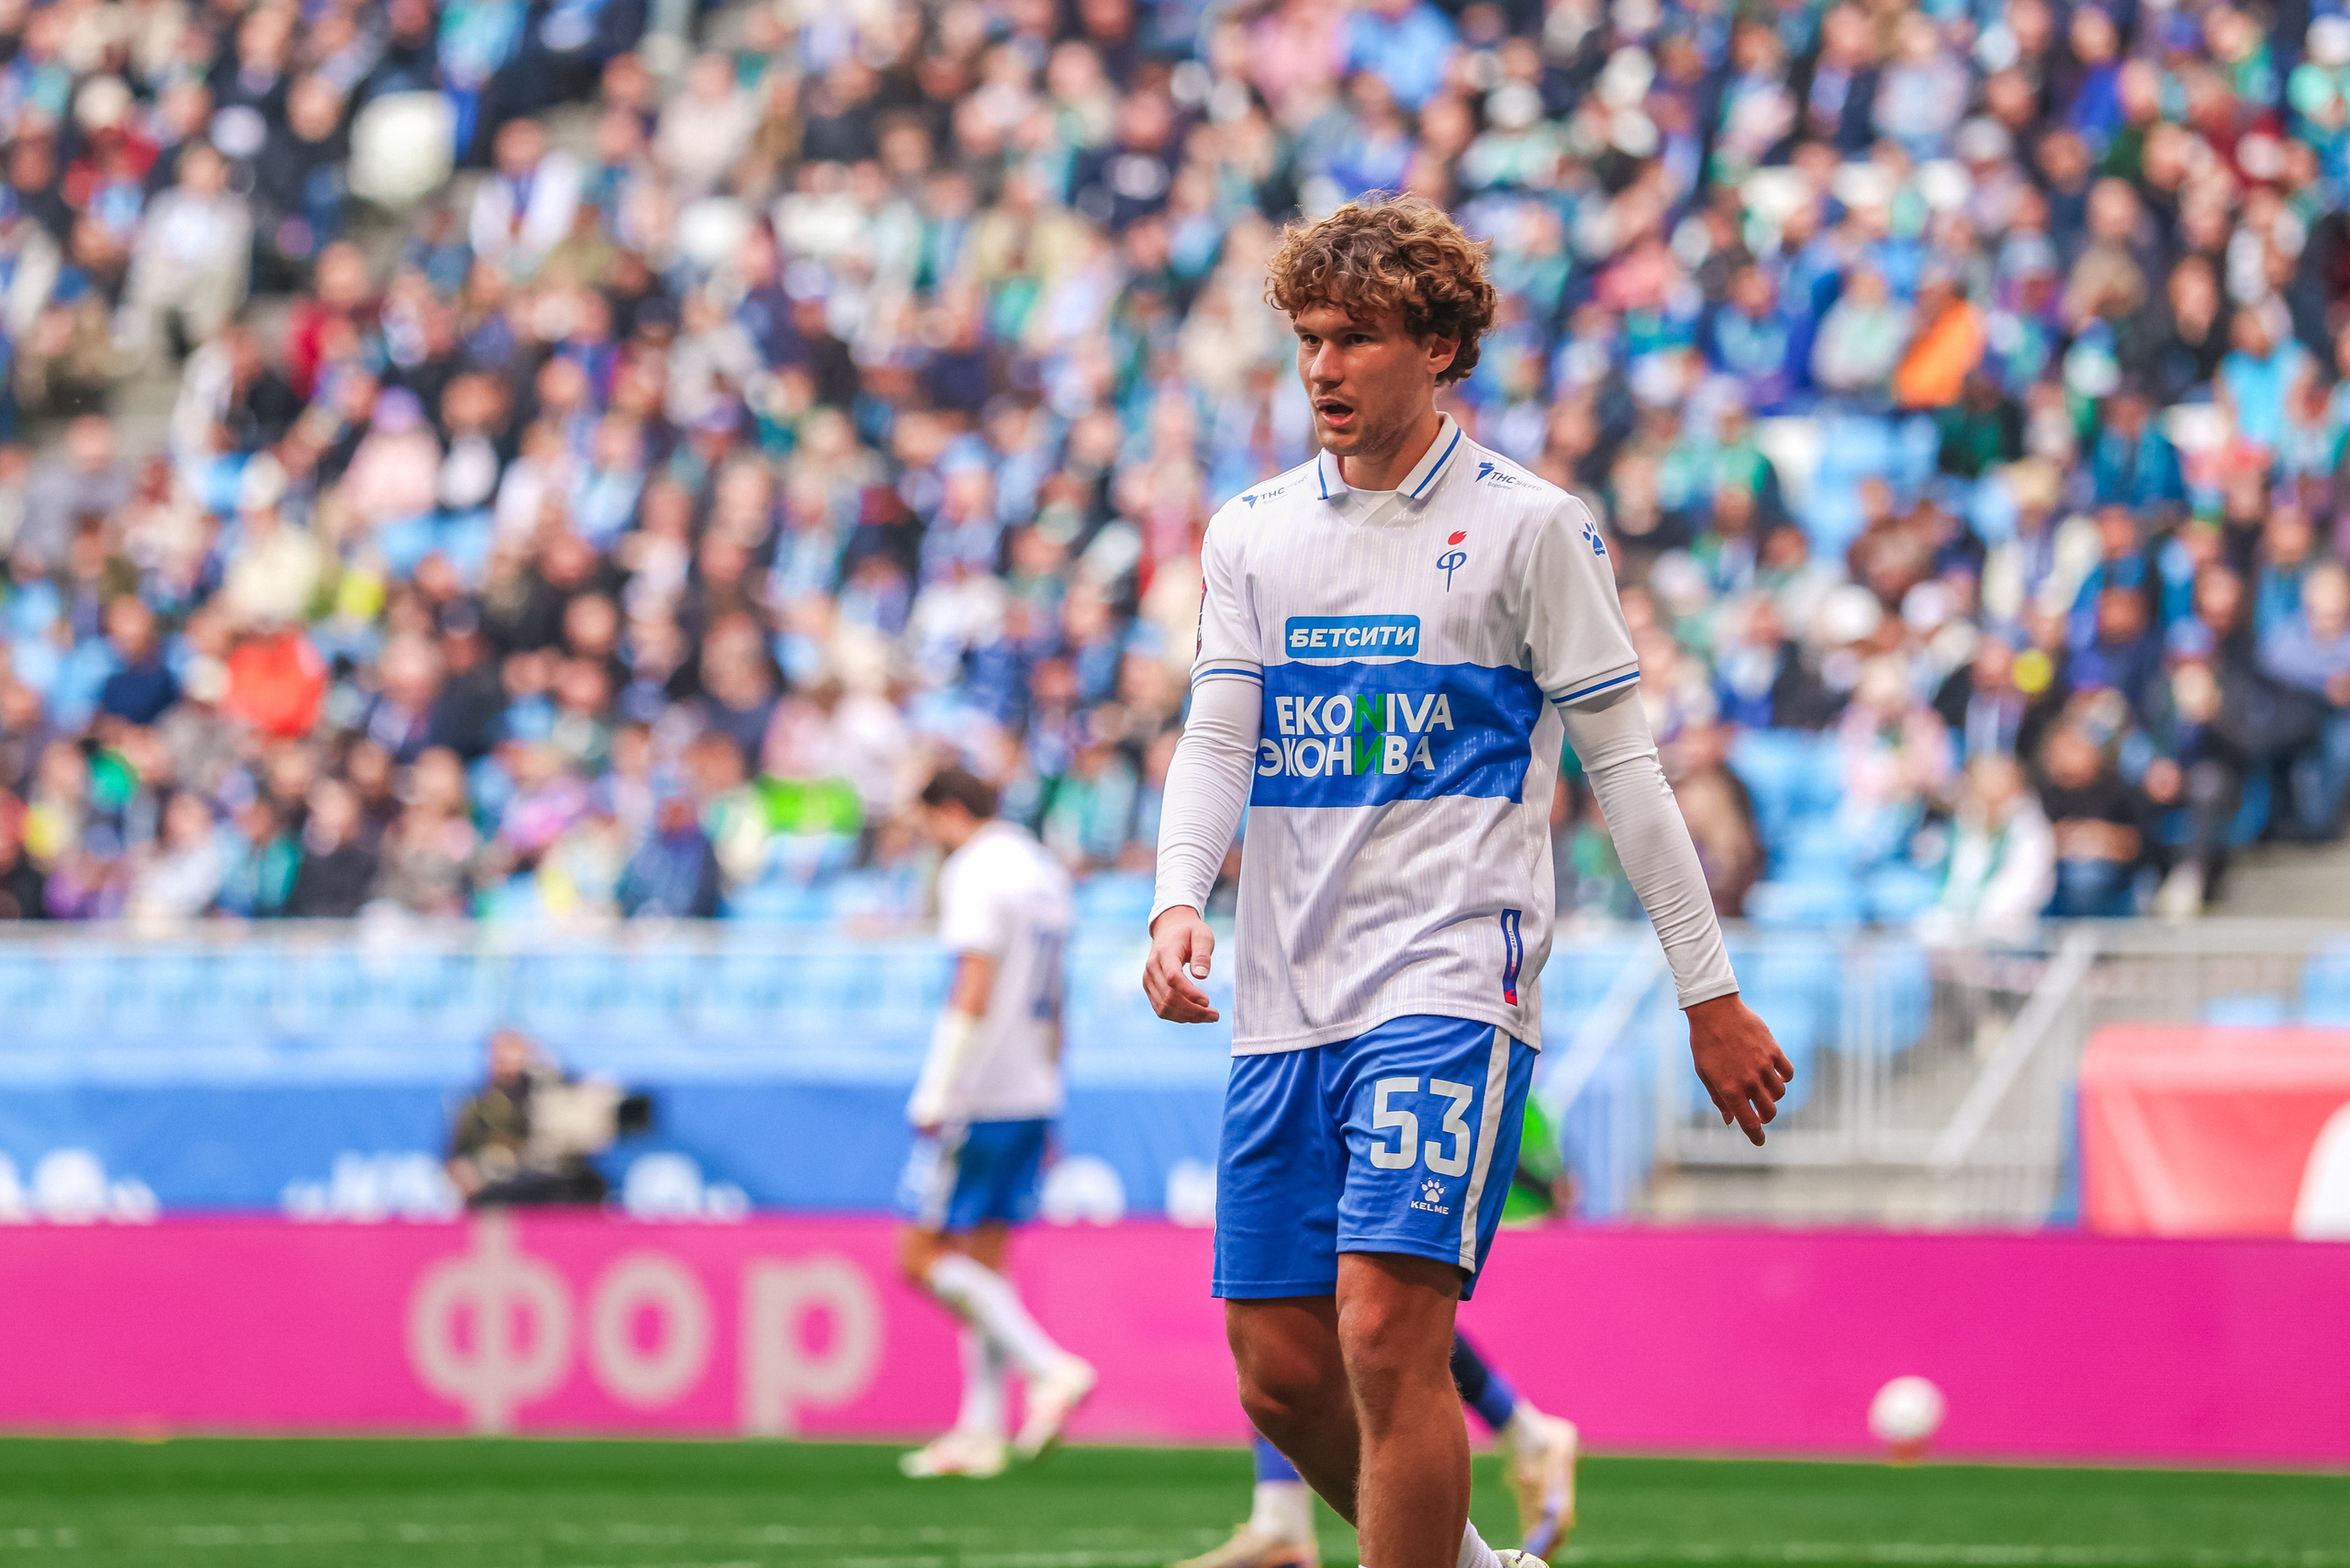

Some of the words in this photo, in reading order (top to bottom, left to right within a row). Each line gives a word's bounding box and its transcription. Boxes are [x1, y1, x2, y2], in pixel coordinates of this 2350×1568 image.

[1491, 471, 1516, 484] ТНС
[1289, 626, 1416, 648] БЕТСИТИ
[1275, 693, 1454, 735] EKONIVA
[1257, 735, 1436, 778] ЭКОНИВА
[1370, 1076, 1473, 1178] 53
[1410, 1200, 1449, 1215] KELME
